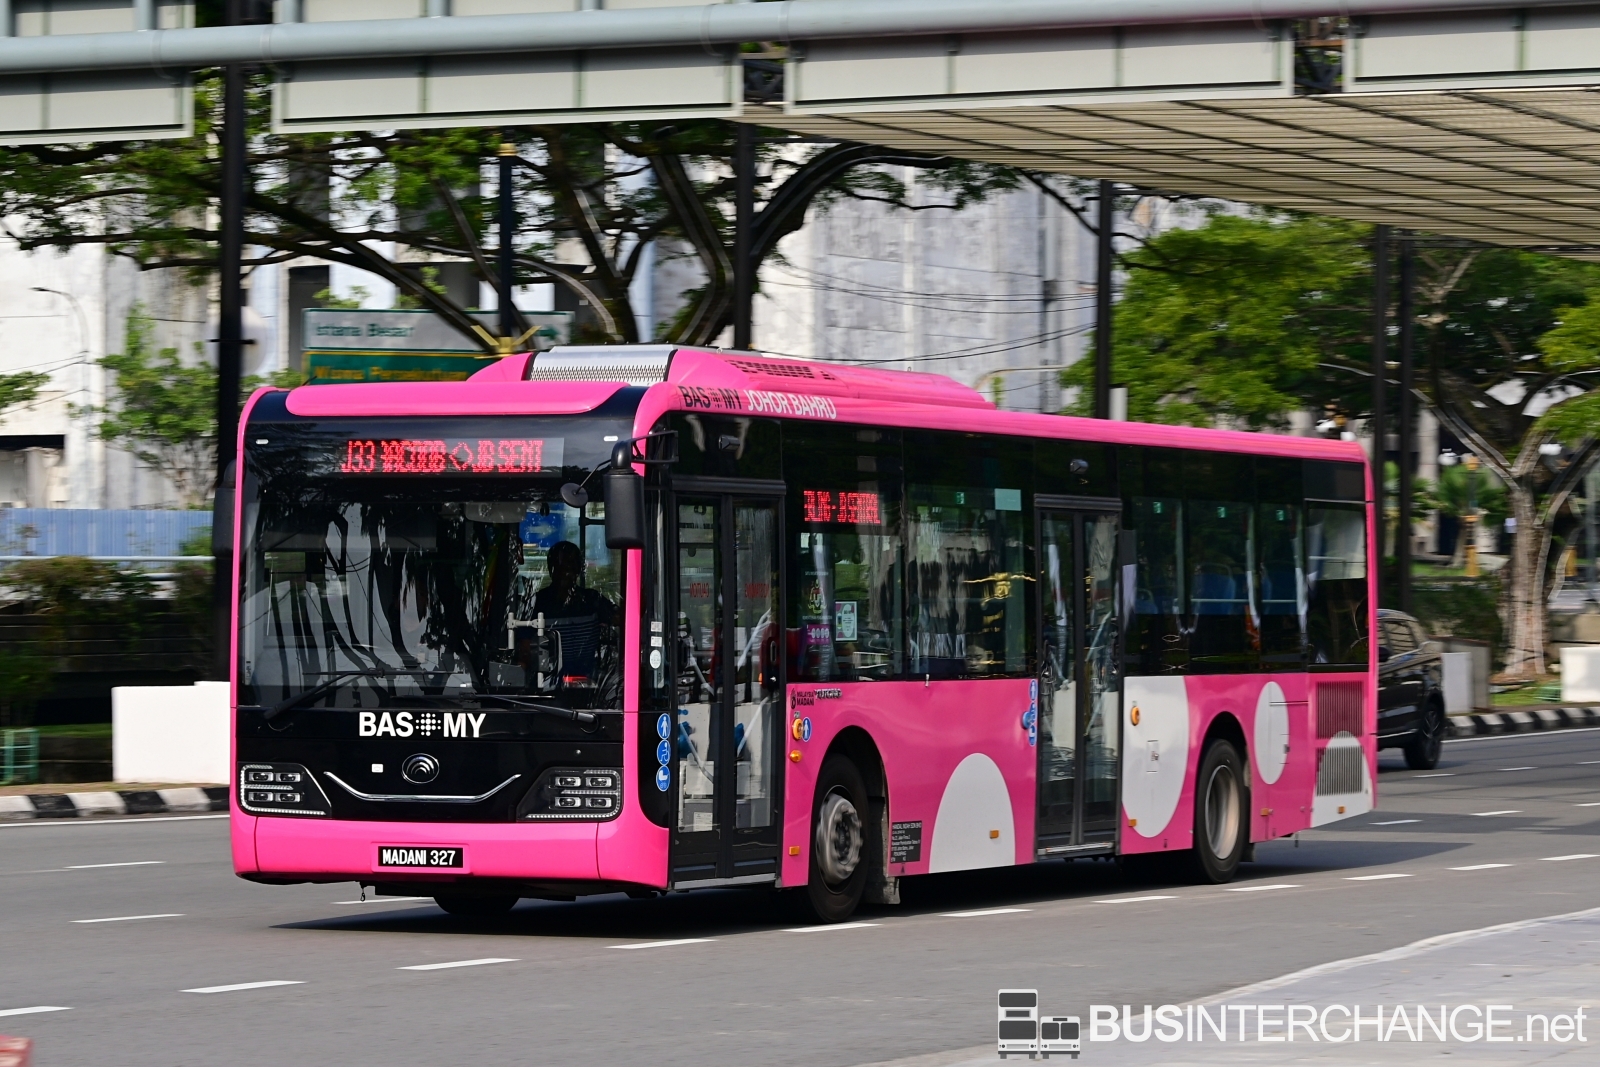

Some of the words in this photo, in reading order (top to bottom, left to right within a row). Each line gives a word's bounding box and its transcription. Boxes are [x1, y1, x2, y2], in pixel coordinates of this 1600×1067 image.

[367, 323, 414, 338] Besar
[678, 386, 711, 408] BAS
[720, 388, 742, 409] MY
[743, 390, 793, 414] JOHOR
[793, 394, 837, 419] BAHRU
[796, 697, 815, 706] MADANI
[358, 711, 414, 738] BAS
[443, 712, 487, 738] MY
[382, 849, 427, 865] MADANI
[430, 850, 456, 866] 327
